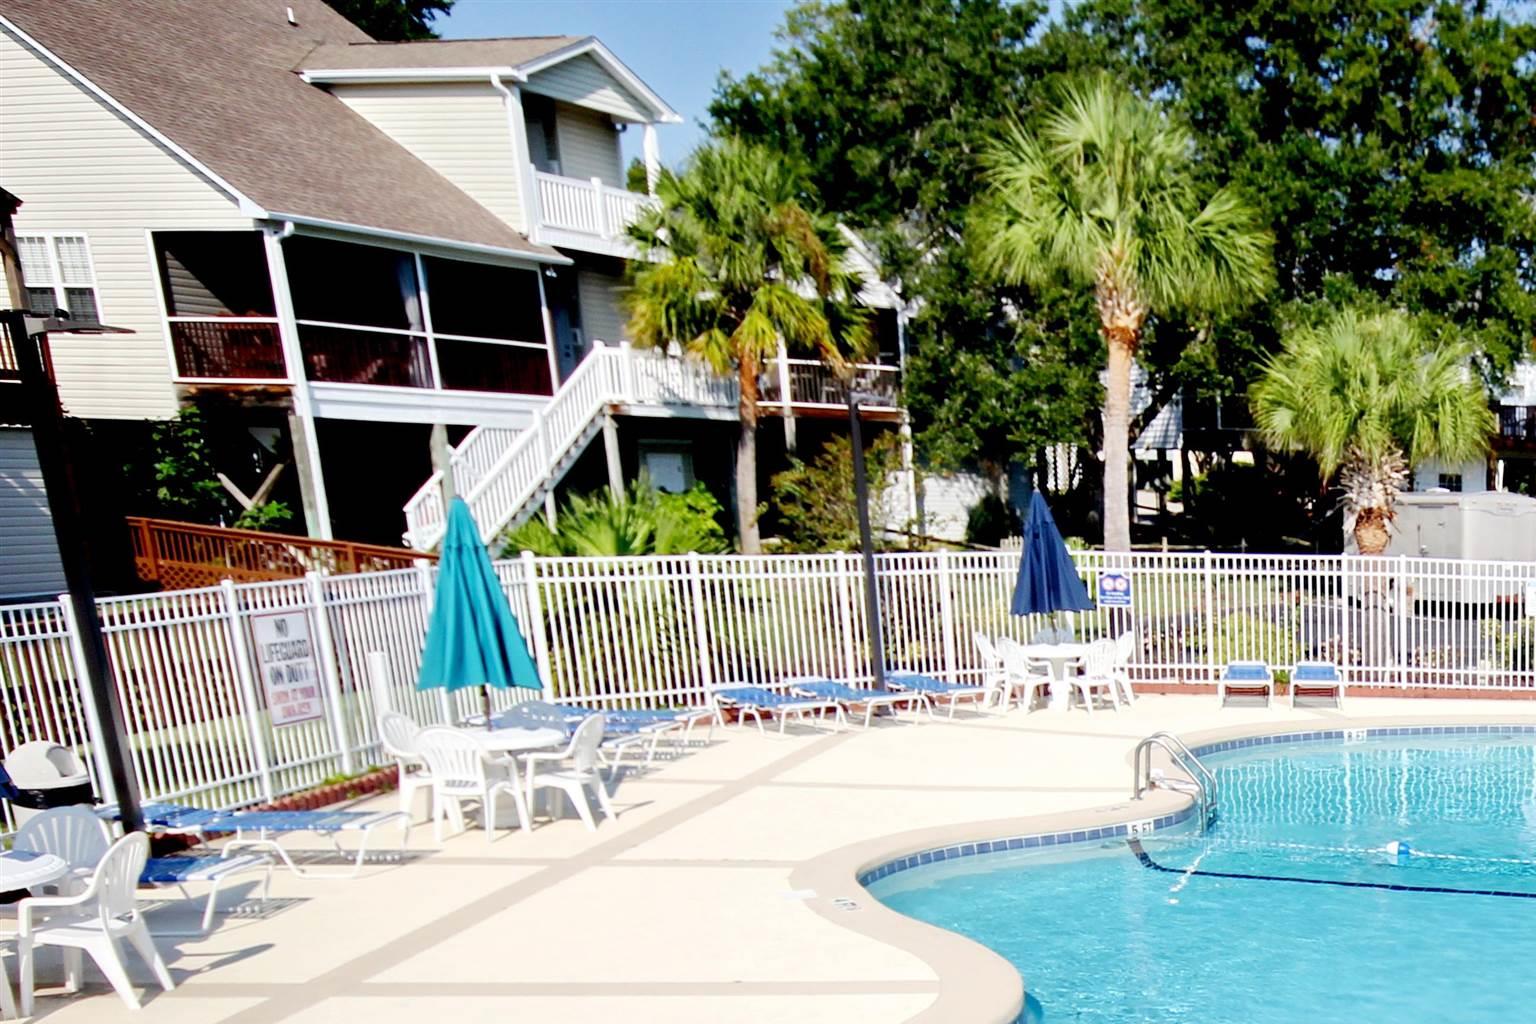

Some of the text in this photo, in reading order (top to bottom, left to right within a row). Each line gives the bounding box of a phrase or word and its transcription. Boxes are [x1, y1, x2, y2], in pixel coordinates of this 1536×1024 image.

[273, 618, 289, 638] NO
[261, 639, 309, 663] LIFEGUARD
[269, 662, 310, 685] ON DUTY
[1142, 822, 1152, 833] FT
